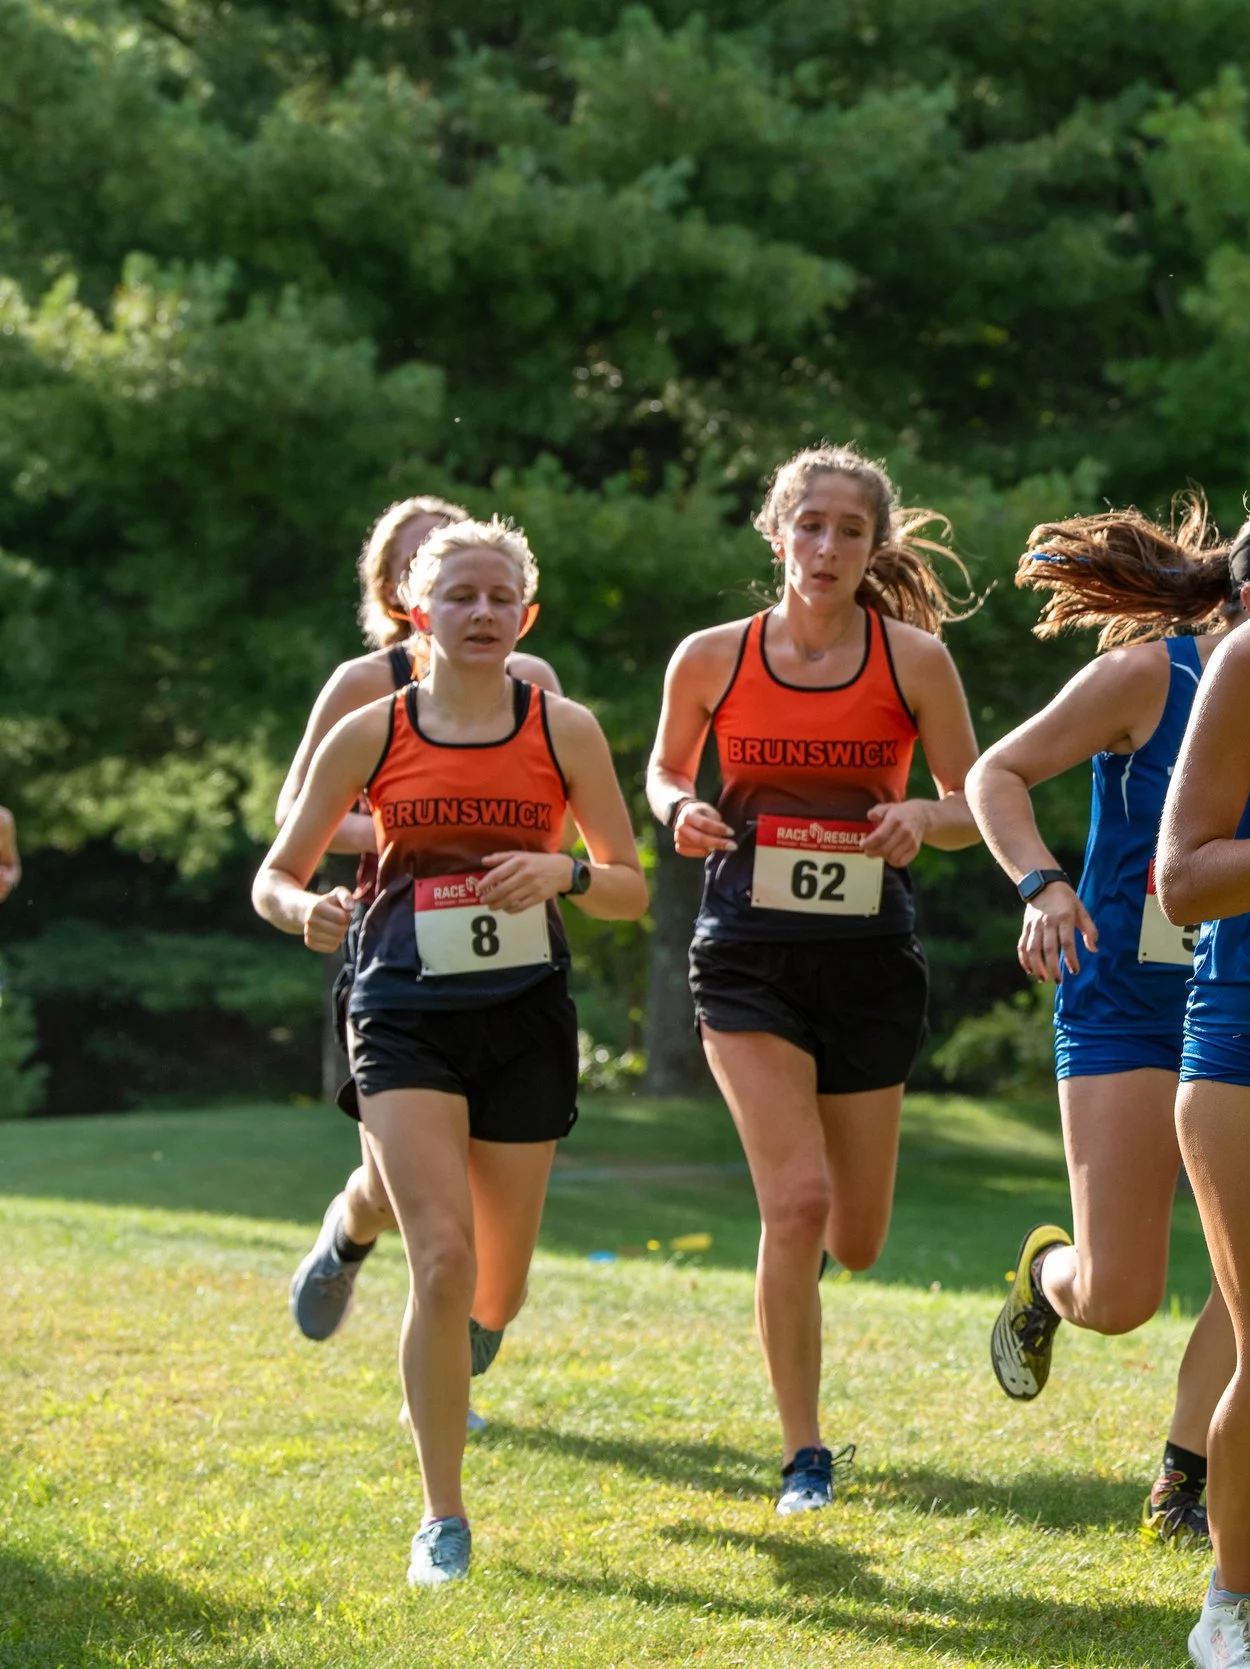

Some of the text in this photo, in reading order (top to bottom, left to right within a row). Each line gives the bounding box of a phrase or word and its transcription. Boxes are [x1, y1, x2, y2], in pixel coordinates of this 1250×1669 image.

[728, 735, 898, 768] BRUNSWICK
[382, 798, 553, 831] BRUNSWICK
[776, 826, 809, 842] RACE
[433, 884, 467, 900] RACE
[790, 860, 846, 902] 62
[471, 915, 500, 957] 8
